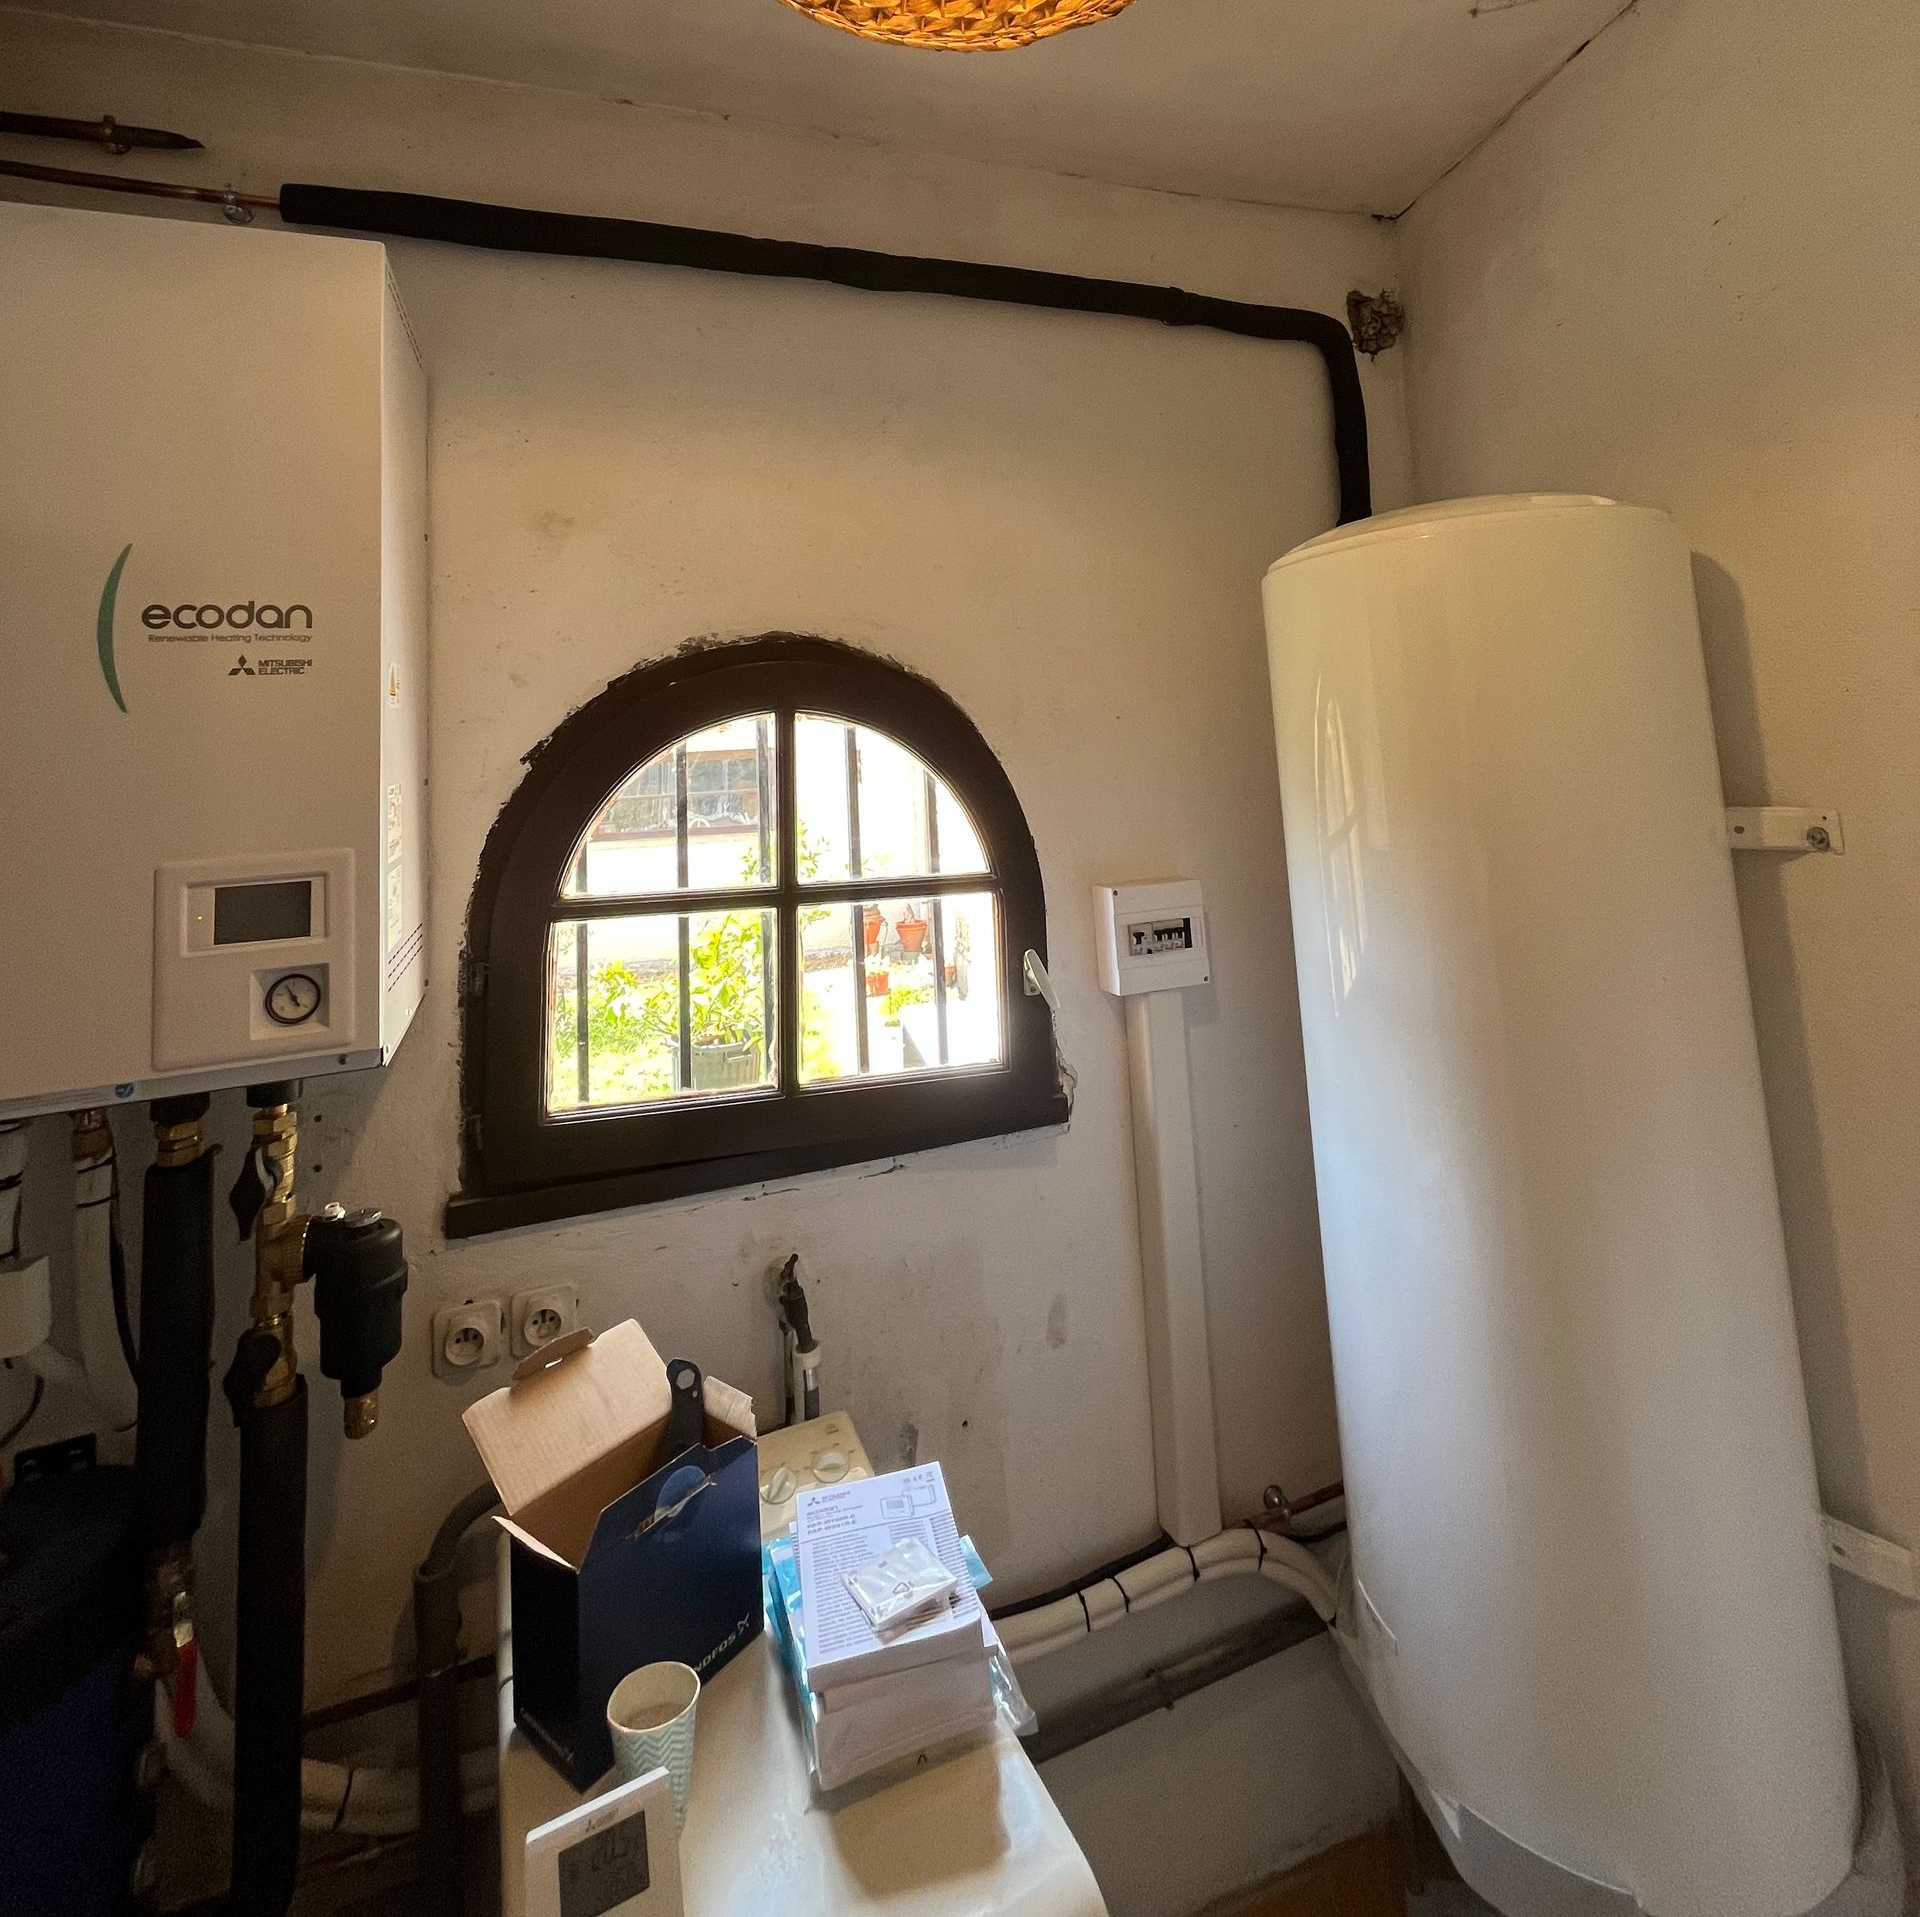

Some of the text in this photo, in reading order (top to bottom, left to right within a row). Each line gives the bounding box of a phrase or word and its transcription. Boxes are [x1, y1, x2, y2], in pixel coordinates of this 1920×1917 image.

[141, 600, 313, 630] ecodan
[148, 633, 313, 644] Renewable Heating Technology
[258, 659, 313, 667] MITSUBISHI
[258, 667, 305, 676] ELECTRIC
[694, 1631, 737, 1673] NDFOS
